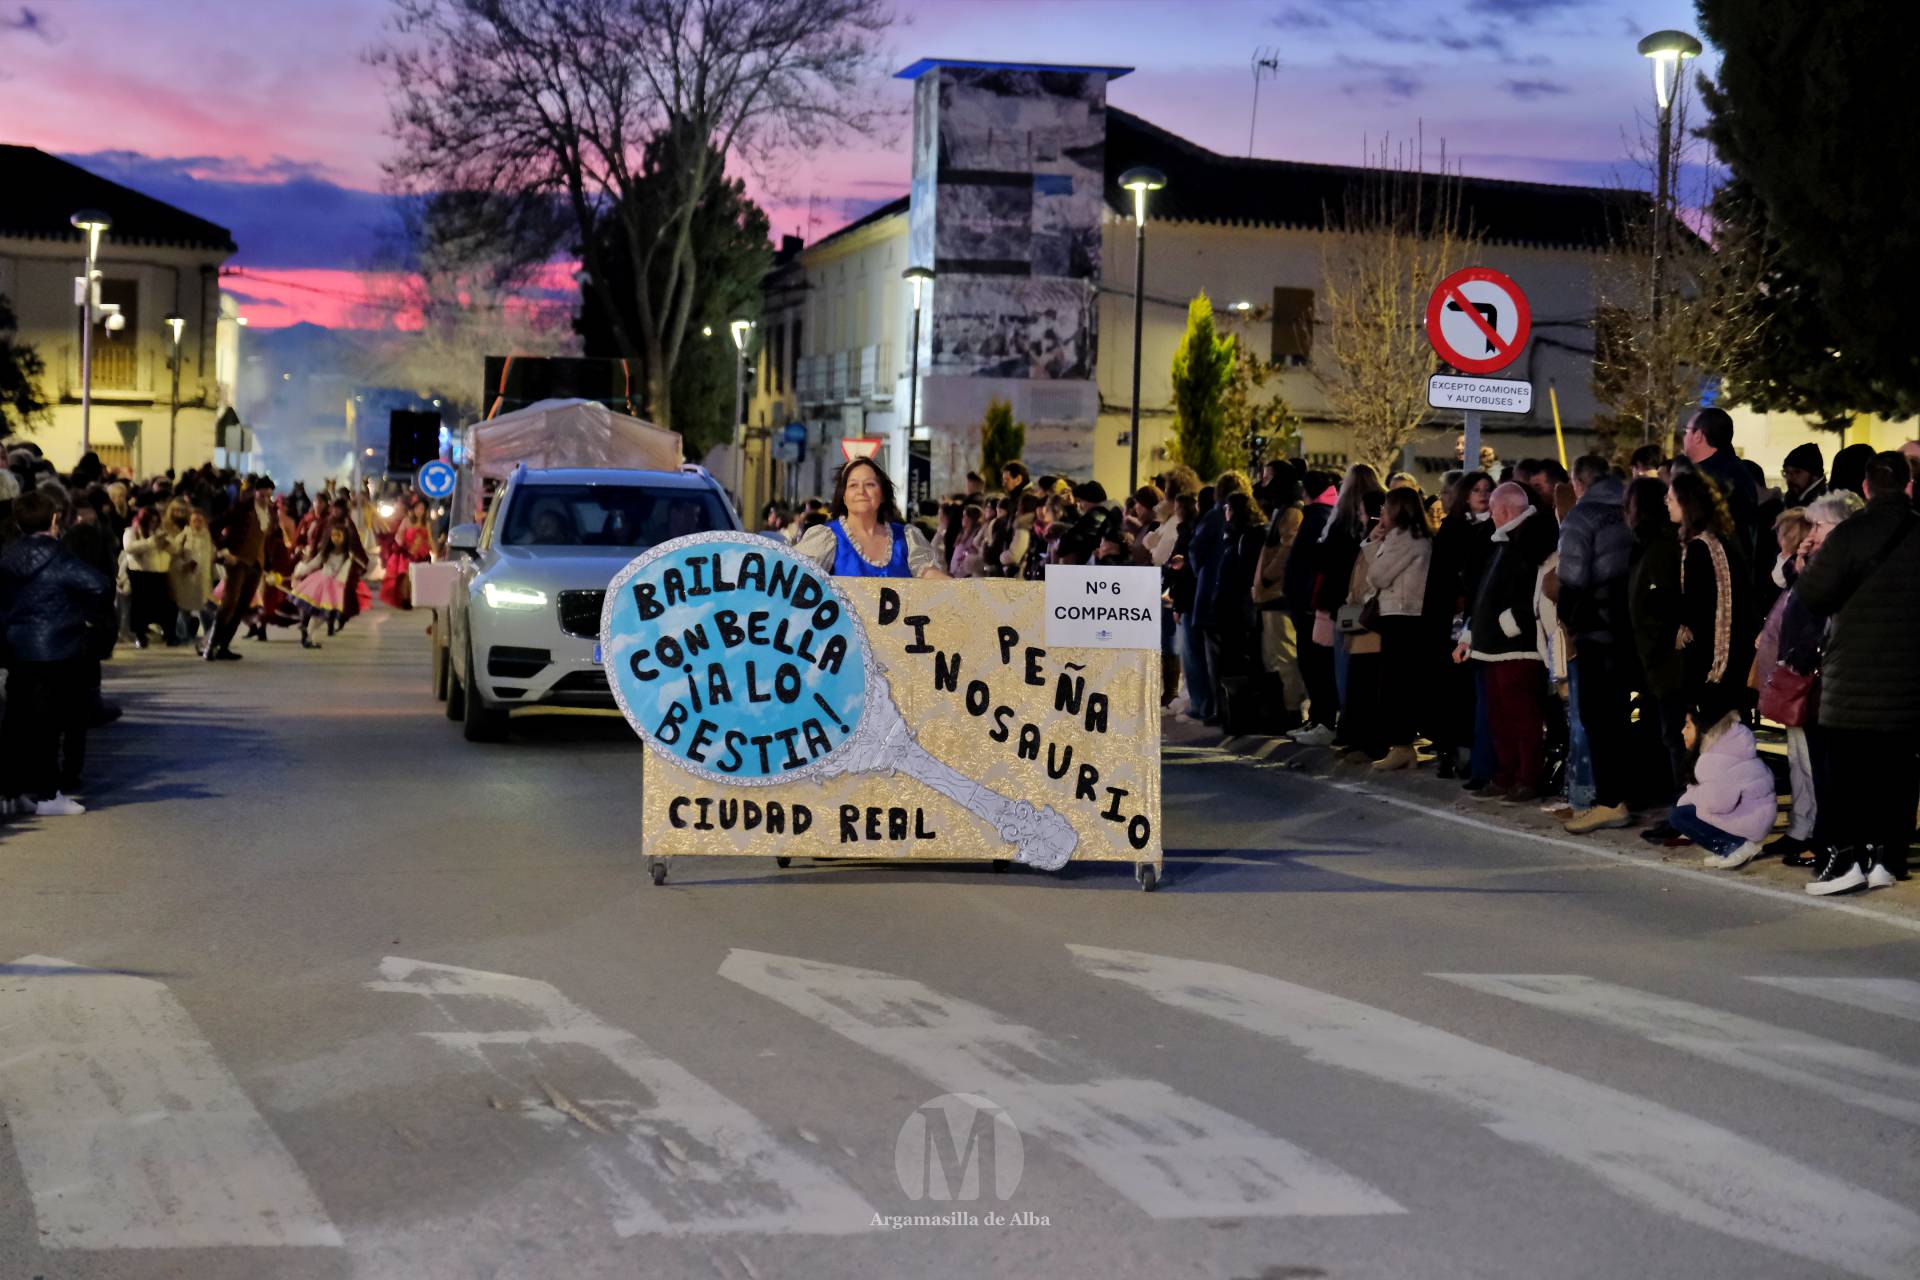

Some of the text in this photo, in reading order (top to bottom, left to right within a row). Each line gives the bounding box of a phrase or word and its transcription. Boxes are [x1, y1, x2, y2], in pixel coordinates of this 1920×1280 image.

[1431, 381, 1529, 396] EXCEPTO CAMIONES
[1456, 395, 1513, 406] AUTOBUSES
[632, 552, 840, 631] BAILANDO
[1086, 581, 1121, 595] Nº 6
[1054, 606, 1152, 621] COMPARSA
[630, 609, 848, 682] CON BELLA
[746, 660, 802, 704] LO
[997, 625, 1109, 733] PEÑA
[654, 692, 850, 774] BESTIA!
[878, 587, 1151, 850] DINOSAURIO
[668, 796, 936, 843] CIUDAD REAL
